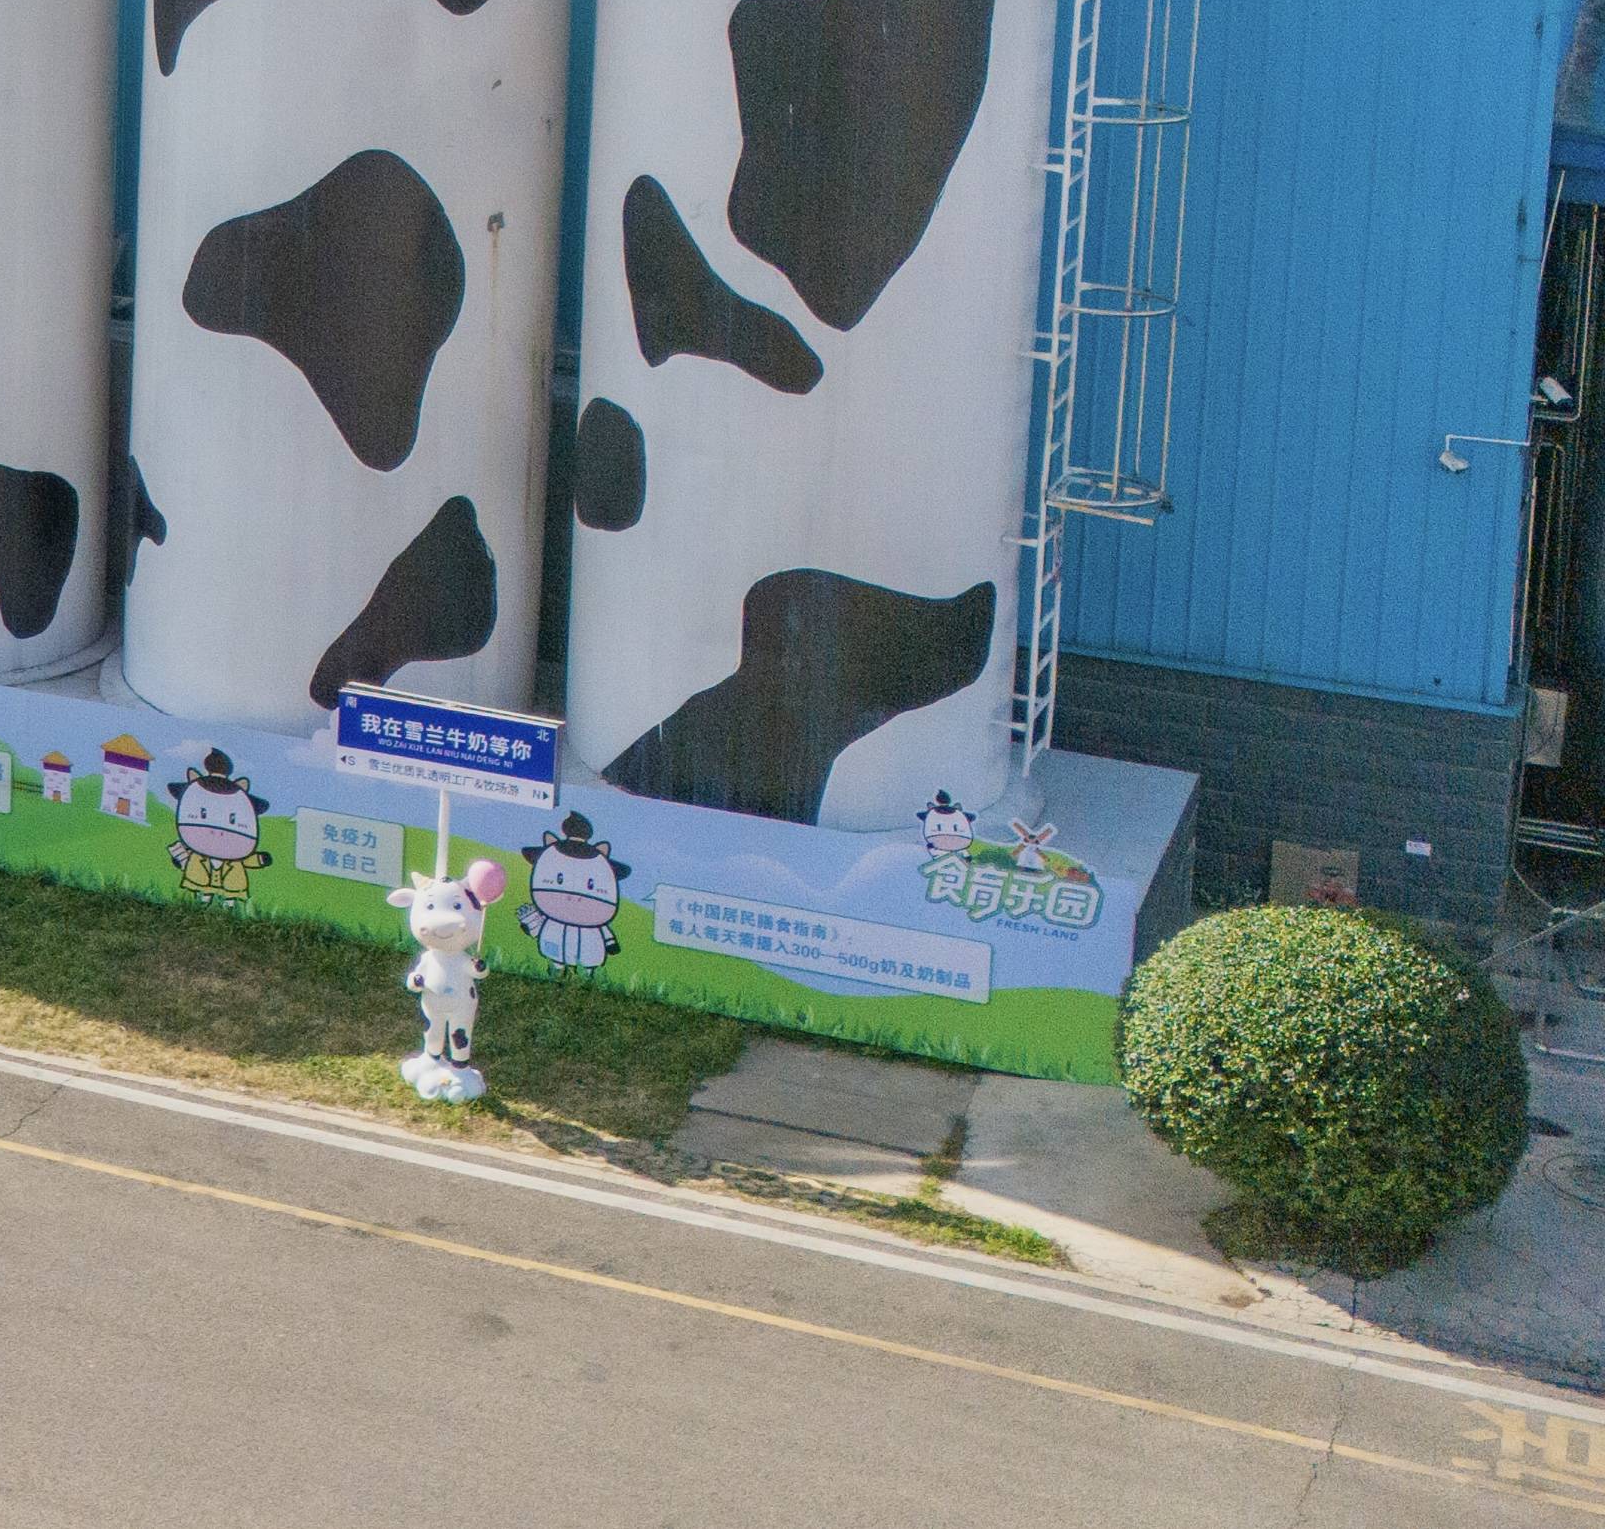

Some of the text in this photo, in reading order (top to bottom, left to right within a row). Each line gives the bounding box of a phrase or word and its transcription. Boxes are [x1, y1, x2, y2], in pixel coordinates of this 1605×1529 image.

[345, 696, 358, 709] 南
[361, 713, 532, 761] 我在雪兰牛奶等你
[537, 729, 550, 743] 北
[347, 755, 356, 767] S
[323, 824, 377, 849] 免疫力
[919, 853, 1102, 928] 食育乐园
[996, 918, 1080, 942] FRESH LAND
